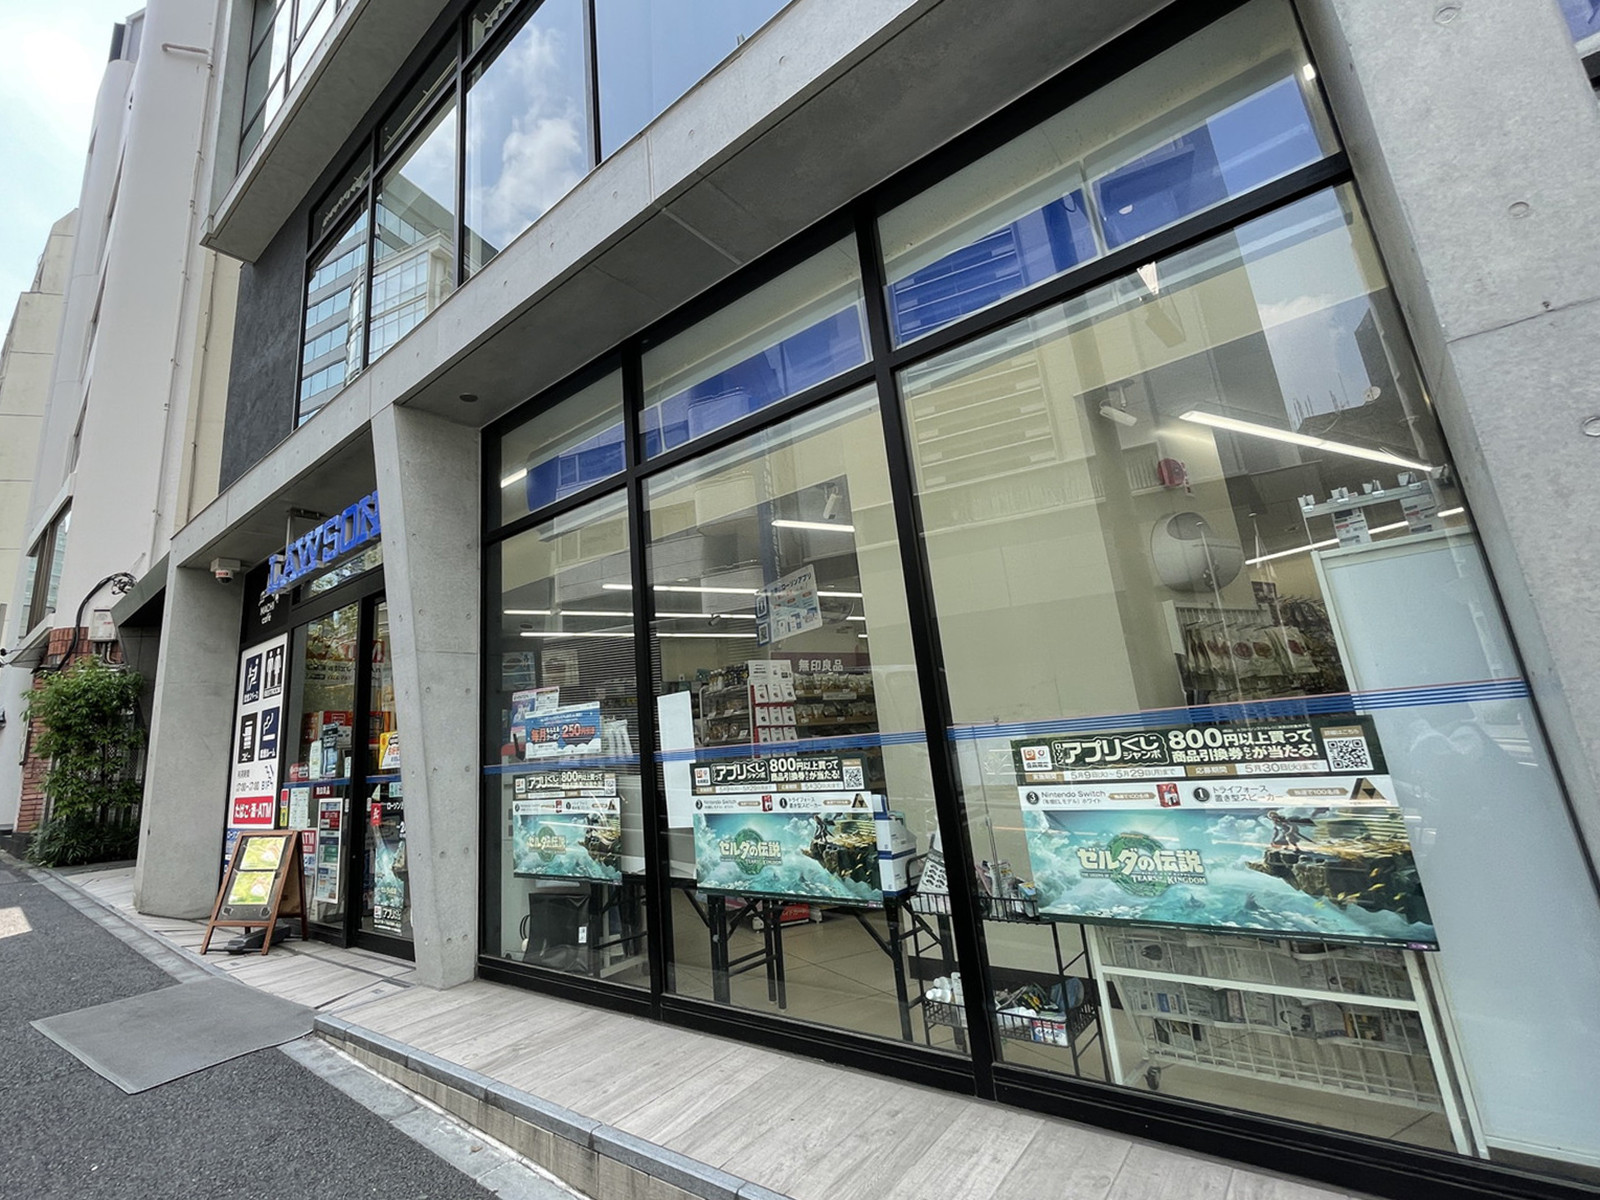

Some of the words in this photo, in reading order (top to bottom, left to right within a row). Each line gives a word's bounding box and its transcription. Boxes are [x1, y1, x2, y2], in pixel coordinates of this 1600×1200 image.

[266, 489, 381, 595] LAWSON
[798, 659, 844, 672] 無印良品
[1168, 728, 1312, 750] 800円以上買って
[1062, 736, 1159, 764] アプリくじ
[715, 763, 766, 781] アプリくじ
[769, 758, 838, 772] 800円以上買って
[1077, 790, 1106, 798] Switch
[1213, 785, 1269, 793] トライフォース
[719, 840, 782, 859] ゼルダの伝説
[1077, 848, 1205, 875] ゼルダの伝説
